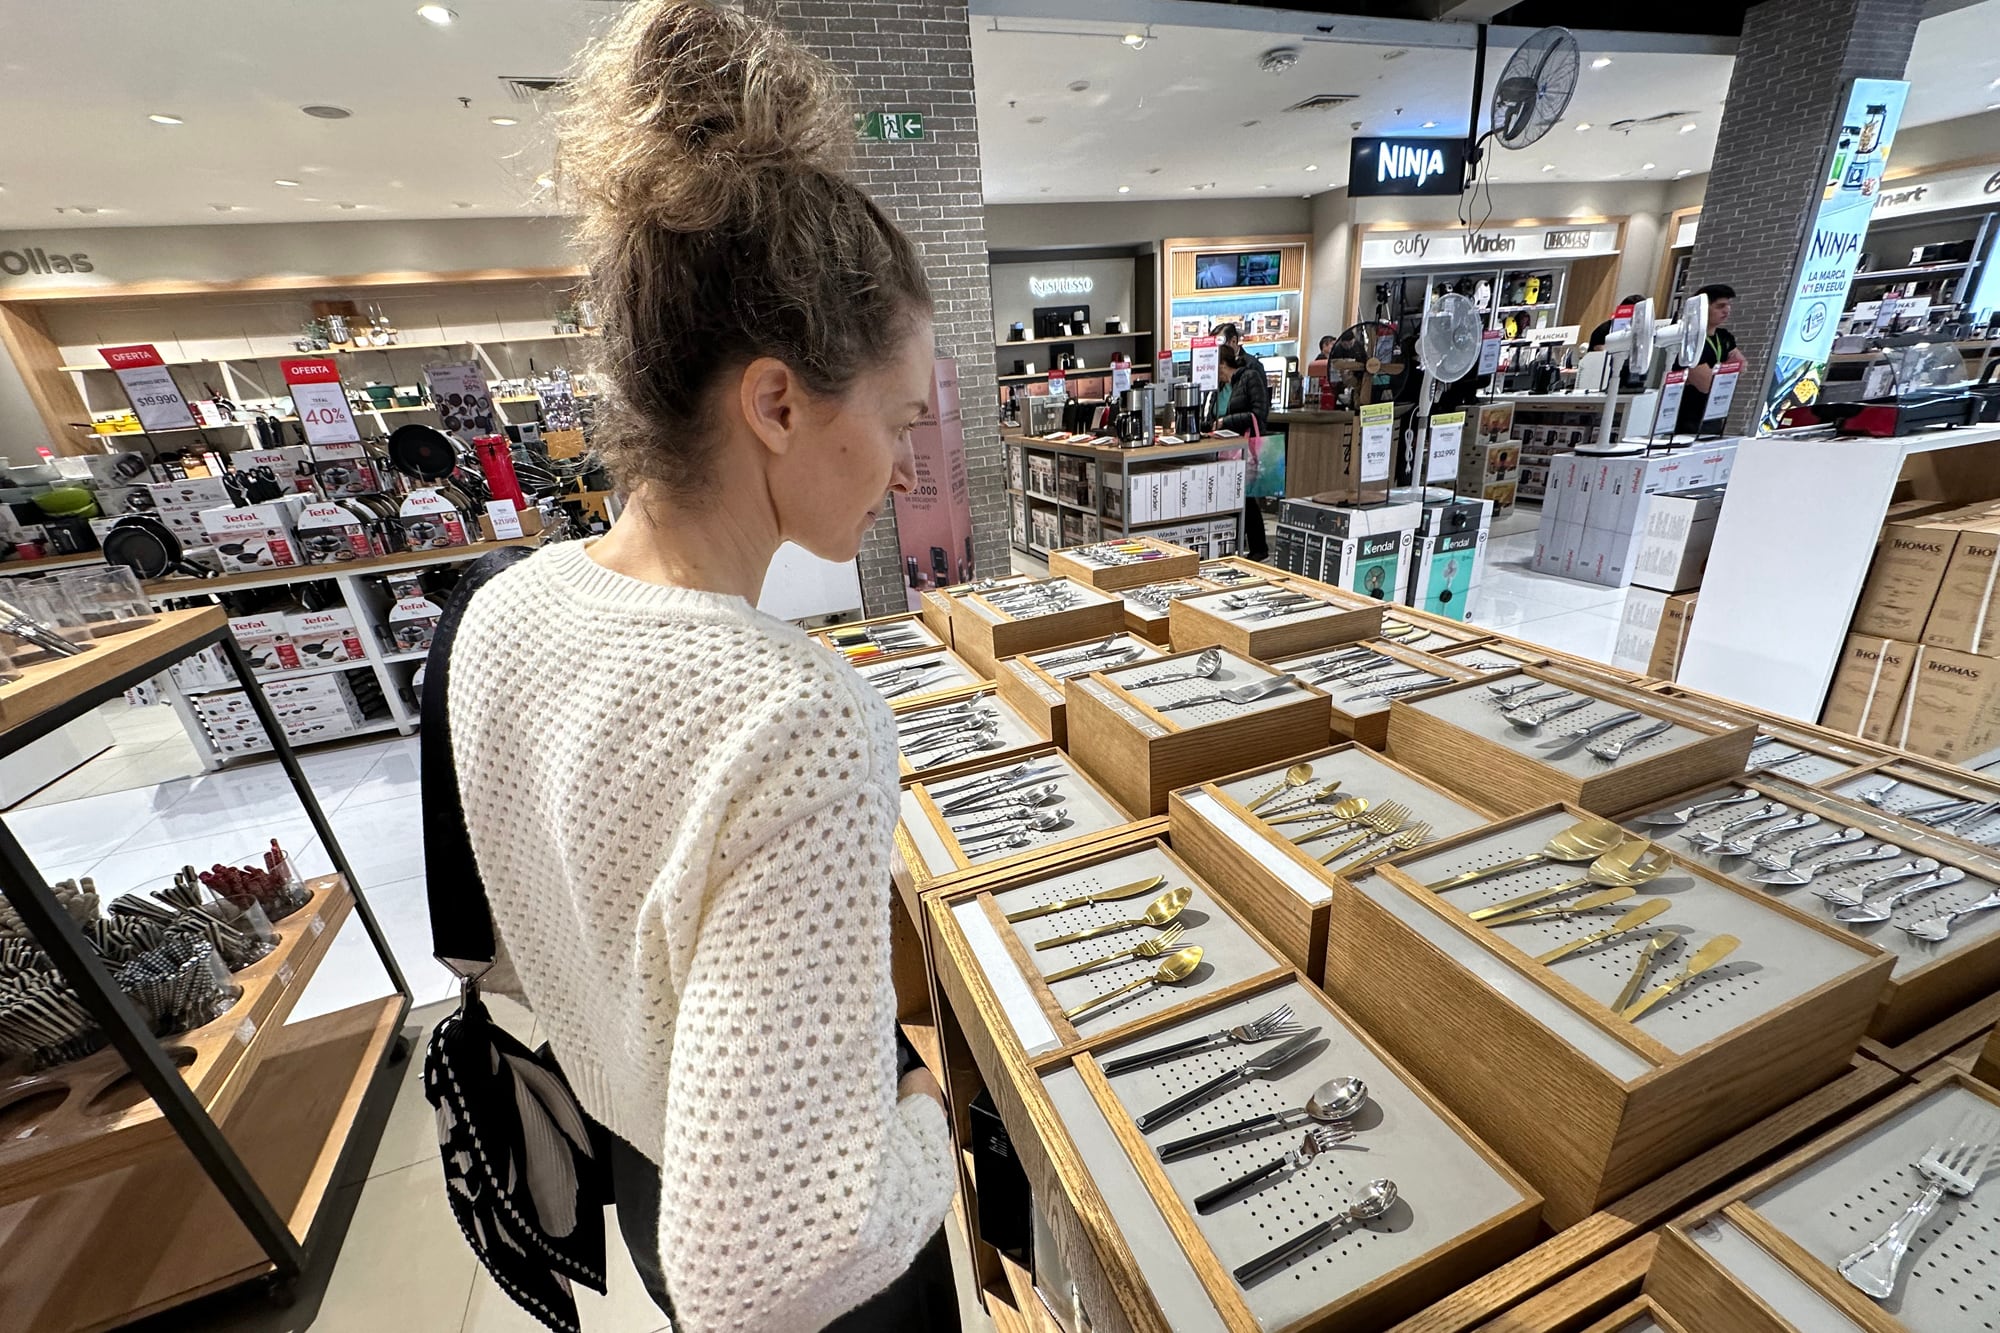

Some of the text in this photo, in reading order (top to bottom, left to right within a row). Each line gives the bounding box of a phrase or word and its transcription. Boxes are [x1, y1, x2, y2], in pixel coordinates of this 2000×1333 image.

[1378, 141, 1444, 187] NINJA
[1394, 233, 1430, 257] eufy
[1463, 234, 1515, 255] Würden
[1809, 228, 1858, 265] NINJA
[0, 247, 95, 276] Ollas
[1808, 269, 1846, 282] LA MARCA
[1813, 282, 1826, 293] EN
[1825, 280, 1847, 292] EEUU
[1535, 332, 1568, 341] PLANCHAS
[111, 350, 153, 362] OFERTA
[290, 365, 330, 376] OFERTA
[305, 407, 345, 426] 40%
[253, 454, 288, 464] Tefal
[409, 496, 439, 506] Tefal
[222, 513, 259, 524] Tefal
[308, 507, 341, 518] Tefal
[1364, 540, 1395, 556] Kendal
[1894, 538, 1942, 553] THOMAS
[399, 601, 428, 611] Tefal
[232, 620, 267, 631] Tefal
[303, 614, 335, 625] Tefal
[1856, 648, 1901, 665] THOAS
[1927, 660, 1981, 679] THOMAS
